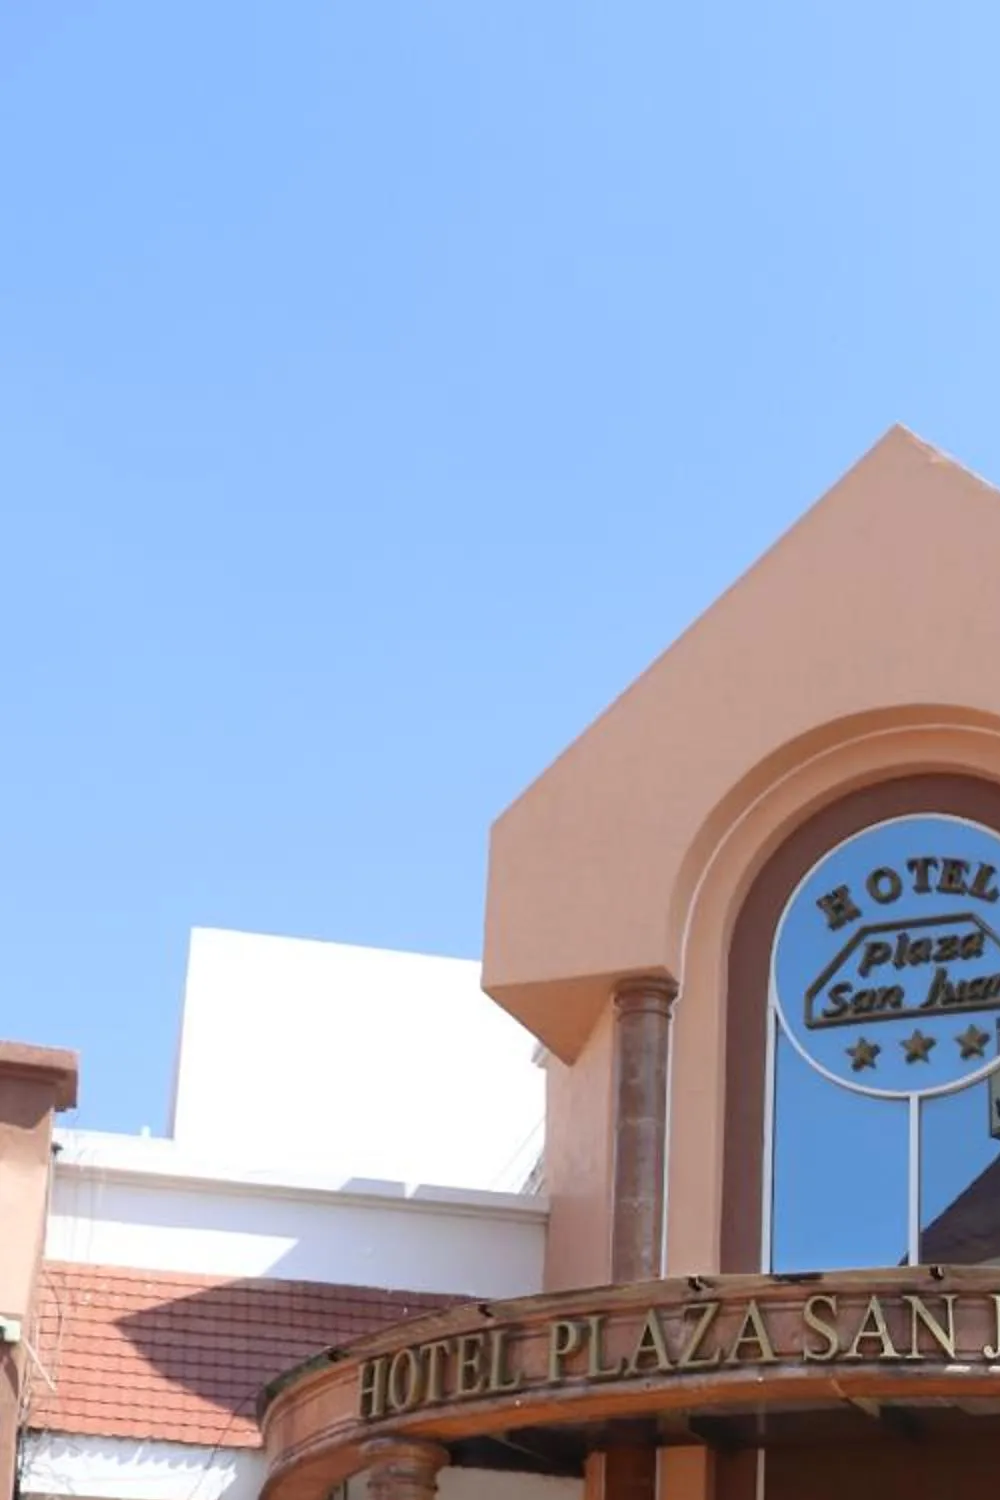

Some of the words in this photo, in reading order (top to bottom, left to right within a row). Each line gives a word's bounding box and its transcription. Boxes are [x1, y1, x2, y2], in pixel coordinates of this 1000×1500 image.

[816, 857, 1000, 931] HOTEL
[822, 981, 905, 1019] San
[357, 1330, 521, 1418] HOTEL
[549, 1299, 778, 1383] PLAZA
[802, 1294, 961, 1361] SAN
